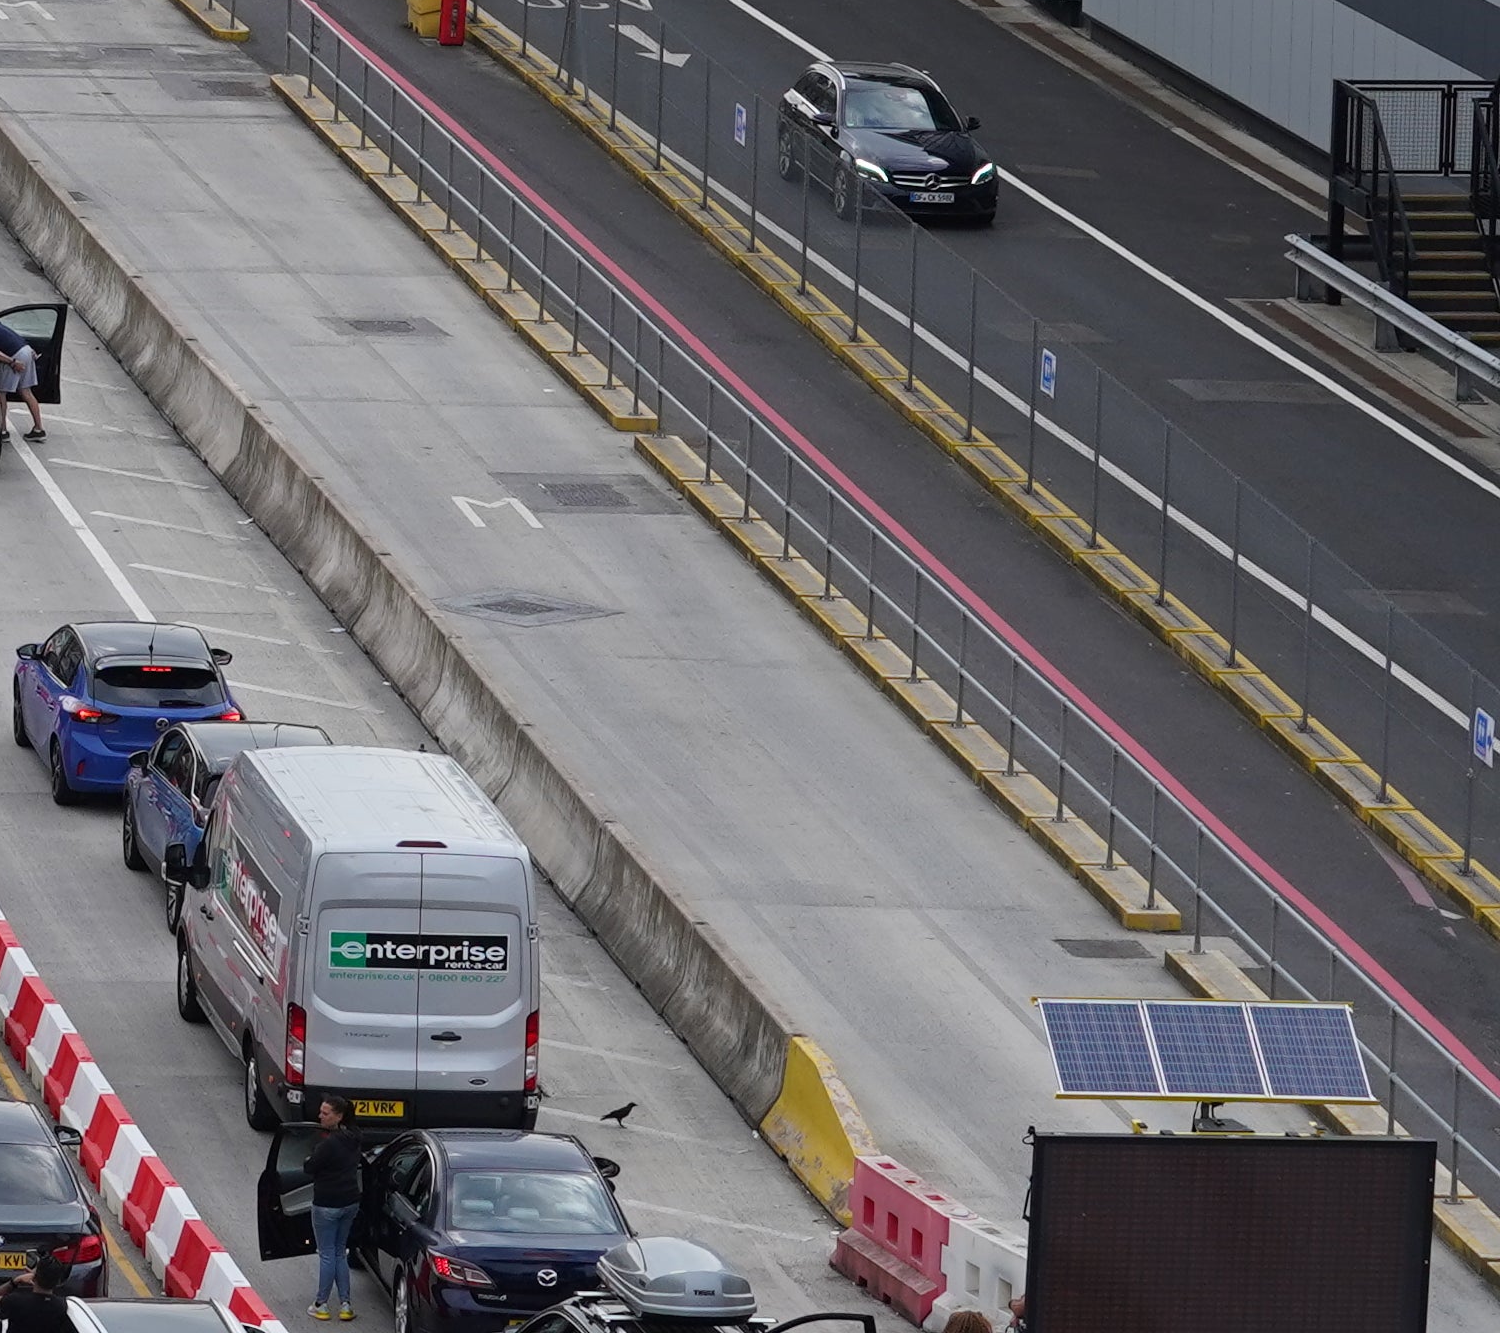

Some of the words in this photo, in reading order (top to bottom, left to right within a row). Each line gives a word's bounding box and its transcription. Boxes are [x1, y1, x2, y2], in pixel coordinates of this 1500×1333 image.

[450, 494, 545, 530] M
[222, 849, 279, 945] enterprise
[330, 939, 507, 968] enterprise
[444, 959, 503, 971] rent-a-car
[328, 971, 416, 983] enterprise.co.uk
[428, 973, 455, 983] 0800
[459, 974, 483, 984] 800
[486, 974, 508, 984] 227
